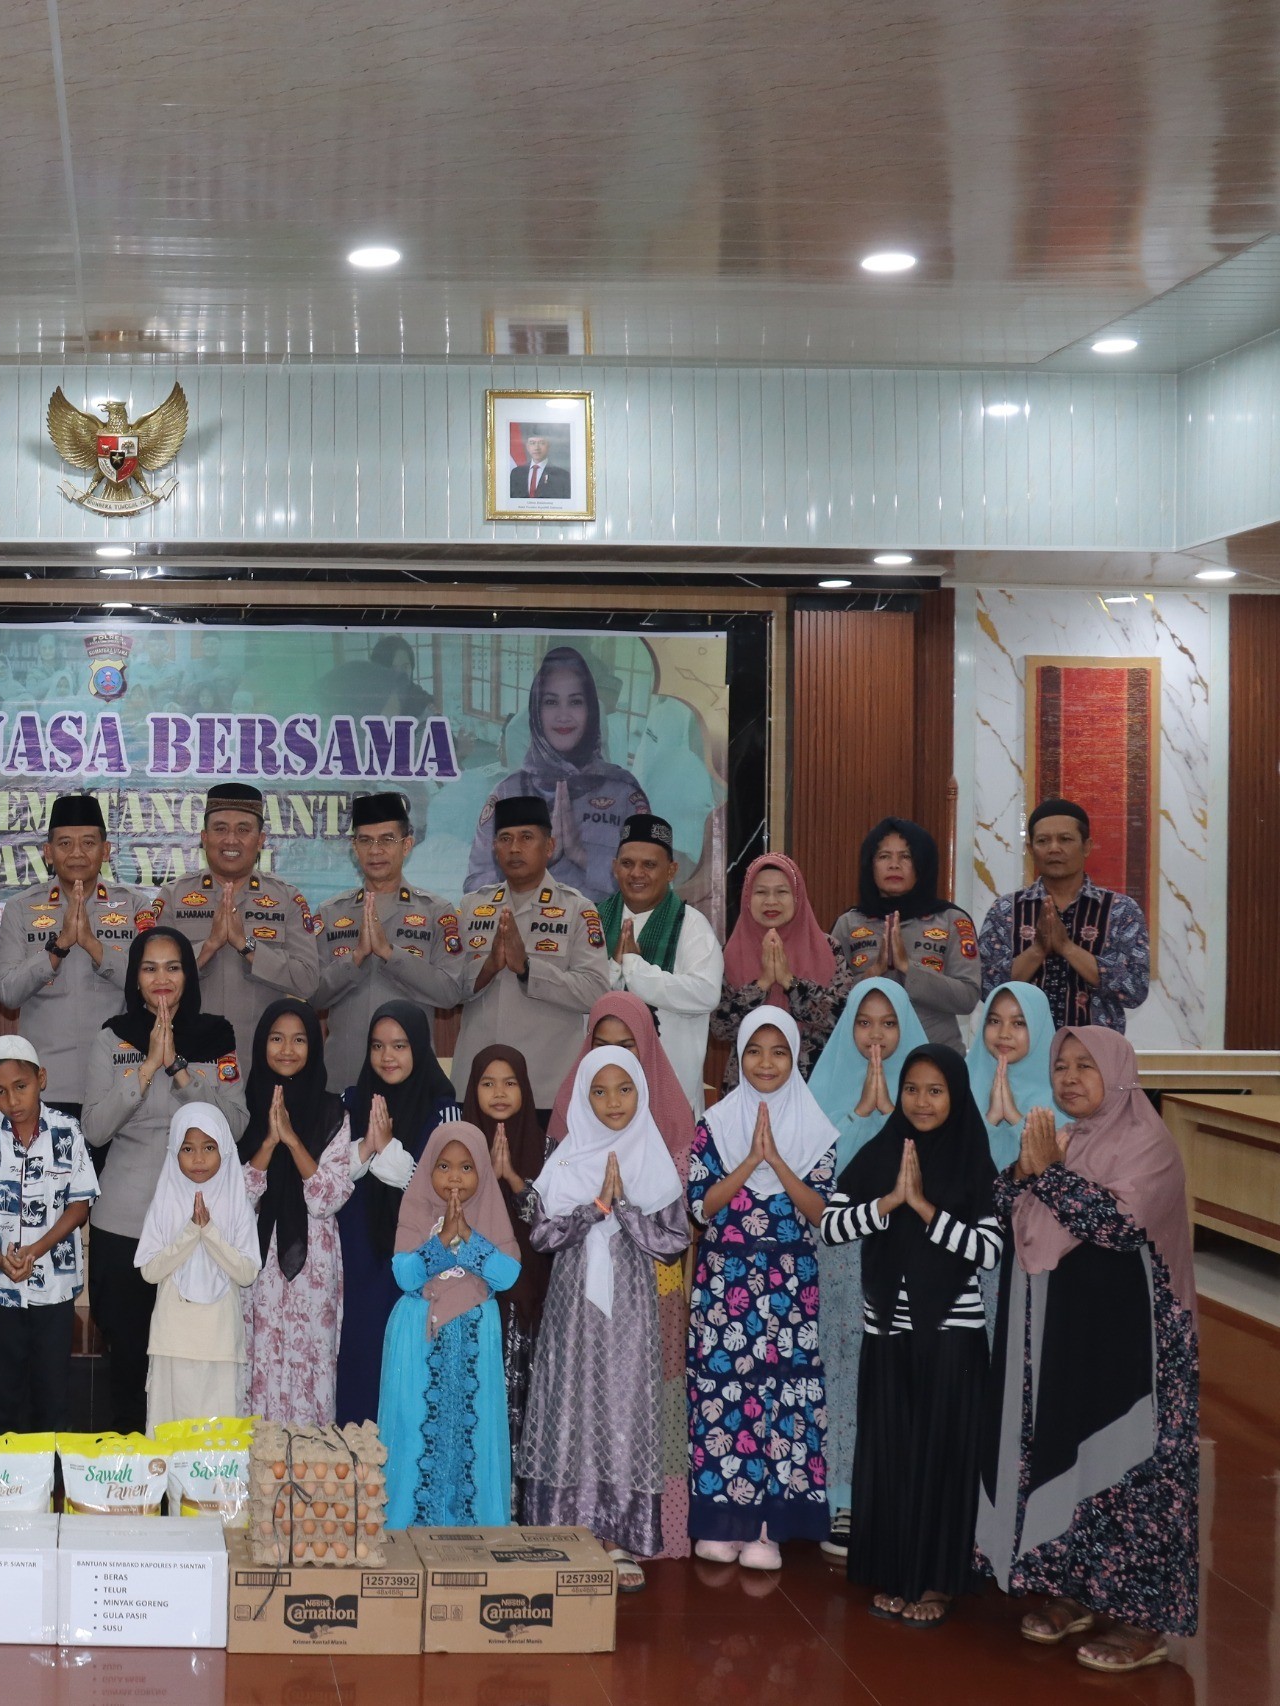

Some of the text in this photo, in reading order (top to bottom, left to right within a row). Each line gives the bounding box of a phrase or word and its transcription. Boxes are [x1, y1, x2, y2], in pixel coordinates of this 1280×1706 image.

[148, 716, 458, 778] BERSAMA
[583, 812, 620, 827] POLRI
[245, 911, 285, 922] POLRI
[468, 920, 495, 931] JUNI
[531, 922, 568, 934] POLRI
[97, 929, 133, 940] POLRI
[396, 928, 431, 941] POLRI
[85, 1463, 133, 1485] Sawah
[190, 1459, 239, 1480] Sawah
[106, 1482, 148, 1500] Panen
[365, 1576, 416, 1586] 12573992
[560, 1573, 610, 1584] 12573992
[104, 1586, 127, 1594] TELUR
[103, 1599, 134, 1607] MINYAK
[287, 1602, 357, 1625] Carnation
[482, 1601, 552, 1624] Carnation
